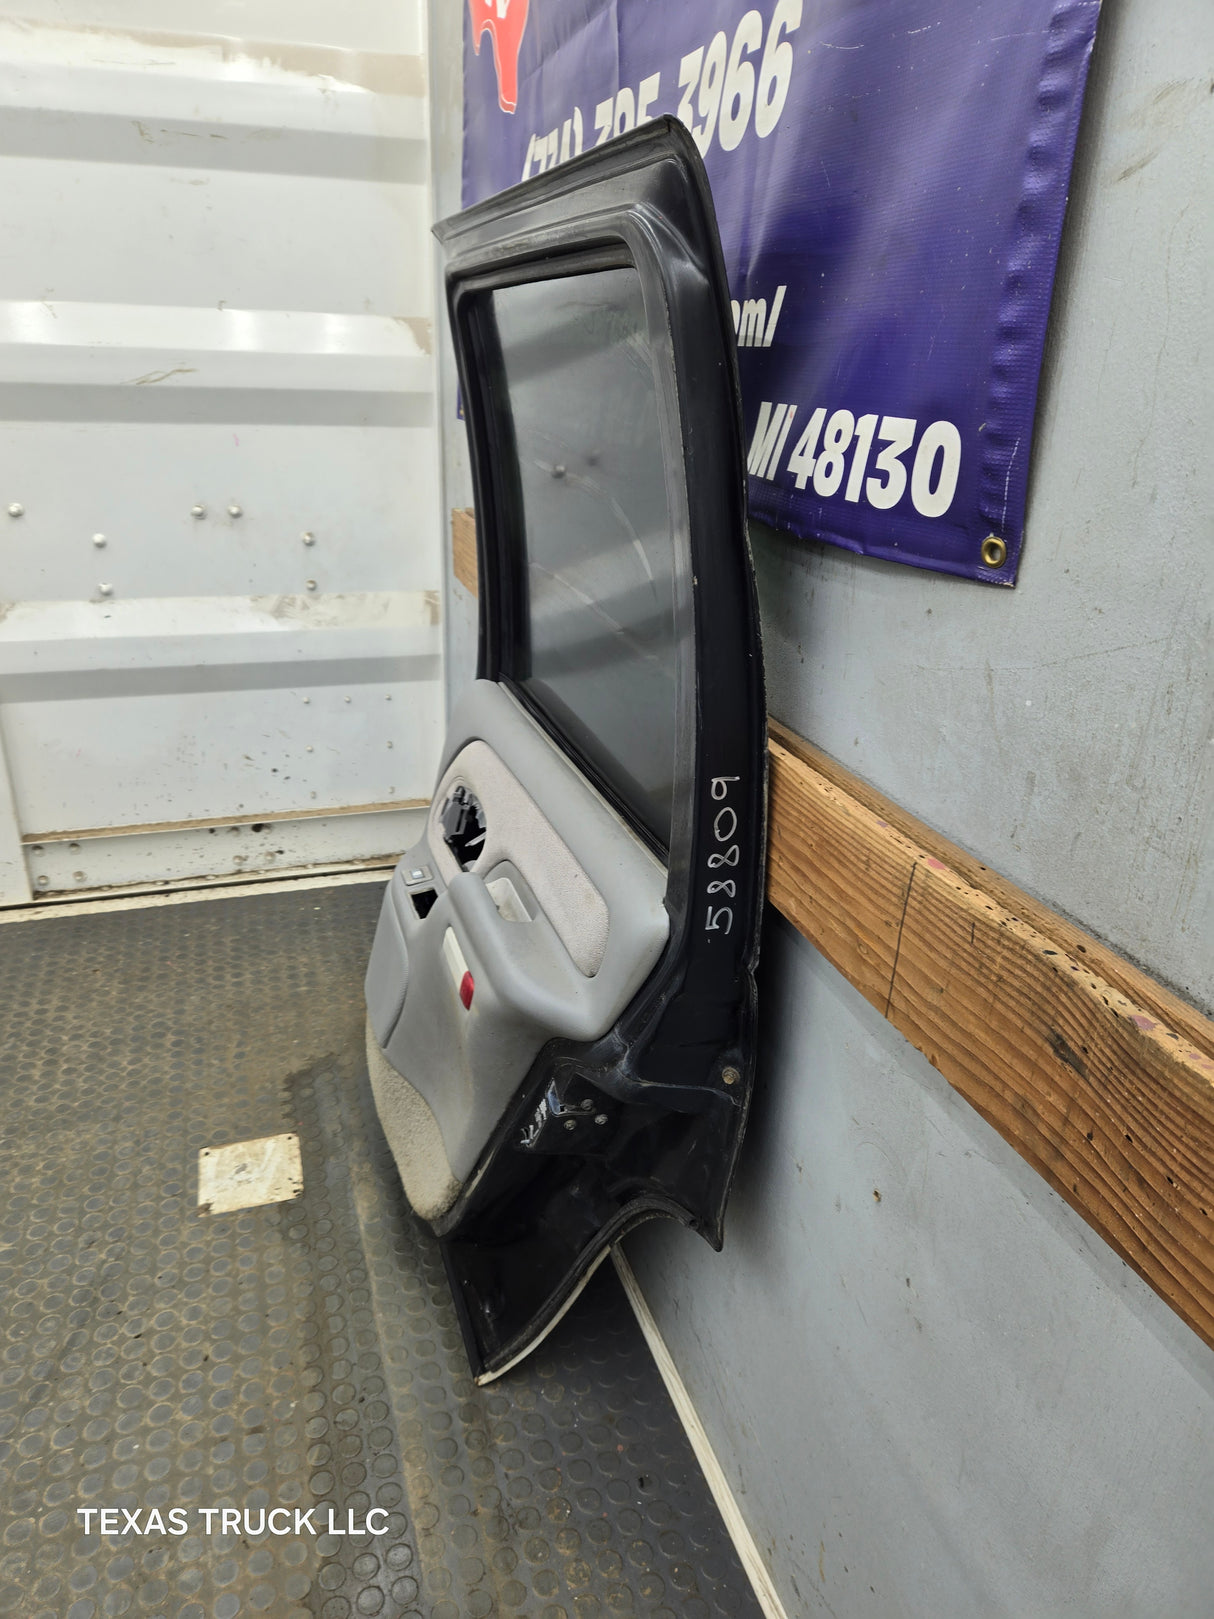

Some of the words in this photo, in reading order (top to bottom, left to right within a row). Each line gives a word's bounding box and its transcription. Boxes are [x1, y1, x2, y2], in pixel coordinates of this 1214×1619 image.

[676, 0, 804, 160] 3966
[746, 401, 798, 481] MI
[786, 407, 963, 518] 48130
[704, 775, 741, 935] 58809
